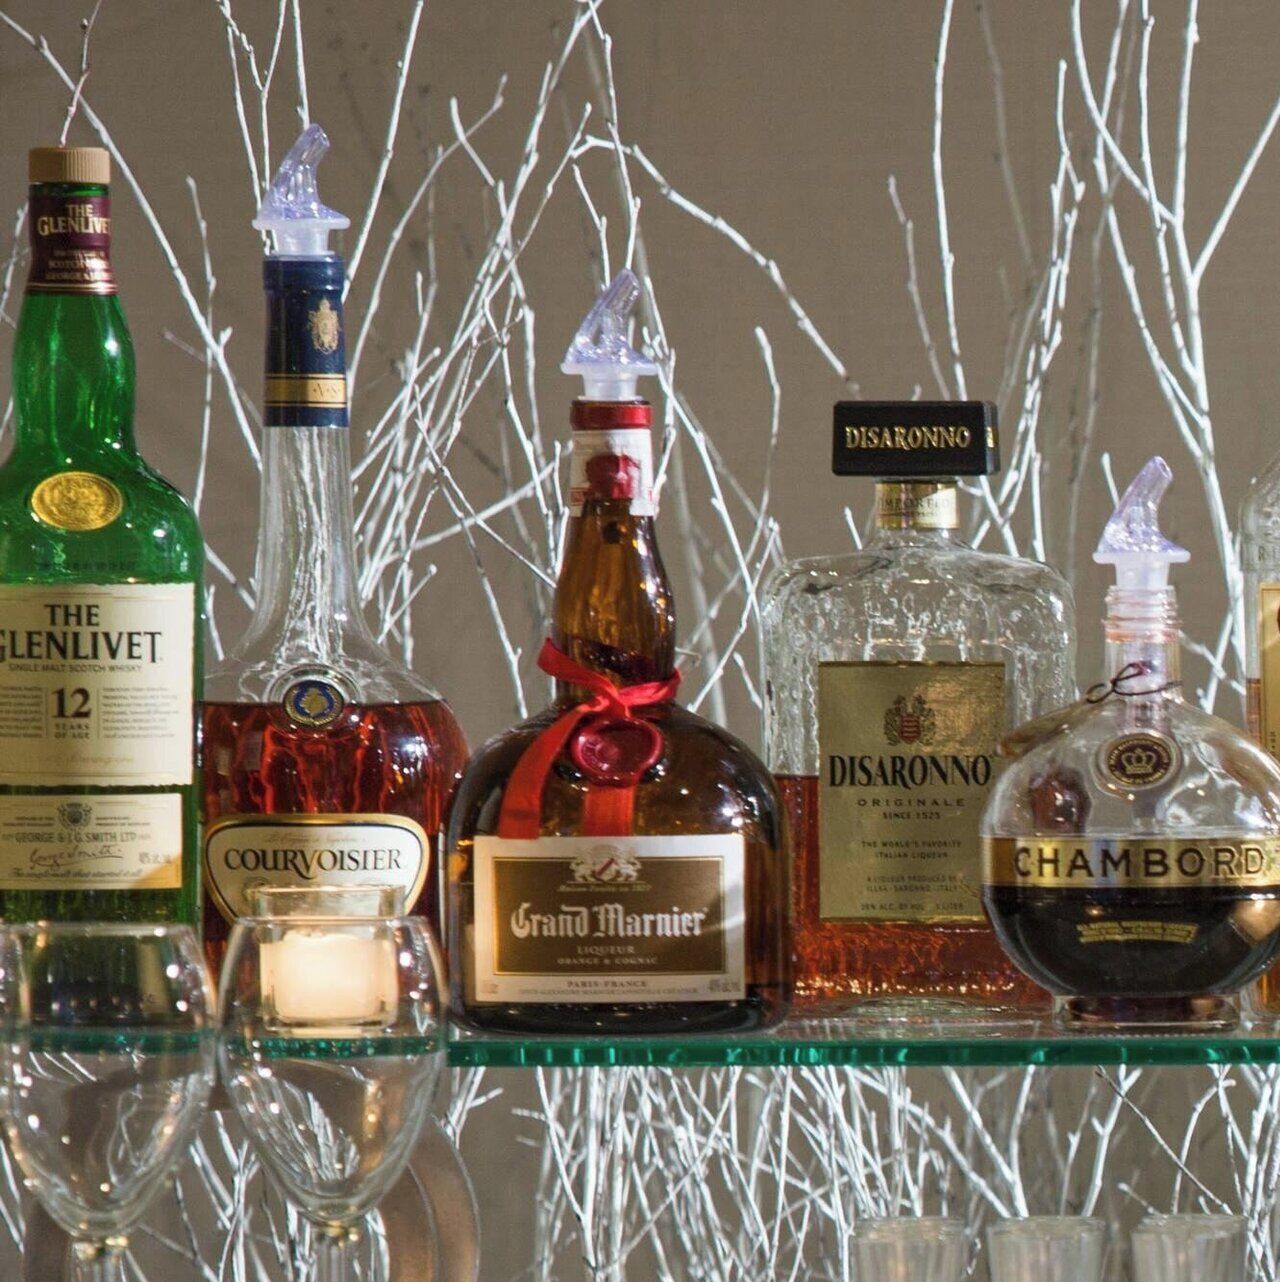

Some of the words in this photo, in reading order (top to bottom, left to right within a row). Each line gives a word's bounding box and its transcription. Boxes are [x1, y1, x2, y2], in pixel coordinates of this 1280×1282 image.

[66, 204, 94, 217] THE
[37, 216, 112, 236] GLENLIVE
[845, 426, 970, 450] DISARONNO
[44, 604, 99, 626] THE
[0, 630, 162, 663] LENLIVET
[9, 664, 39, 672] SINGLE
[42, 664, 66, 672] MALT
[69, 664, 105, 672] SCOTCH
[109, 663, 141, 672] WHISKY
[52, 688, 91, 718] 12
[829, 755, 991, 790] DISARONNO
[857, 799, 965, 807] ORIGINALE
[883, 812, 911, 820] SINCE
[916, 812, 941, 820] 1525
[15, 832, 54, 843] GEORGE
[86, 832, 117, 843] SMITH
[120, 833, 136, 843] LTD
[225, 849, 401, 880] COURVOISIER
[912, 852, 948, 860] LIQUEUR
[1014, 847, 1267, 878] CHAMBORD
[511, 902, 589, 938] Grand
[592, 901, 705, 938] Marnier
[577, 946, 635, 956] LIQUEUR
[567, 980, 599, 988] PARIS
[604, 980, 647, 988] FRANCE
